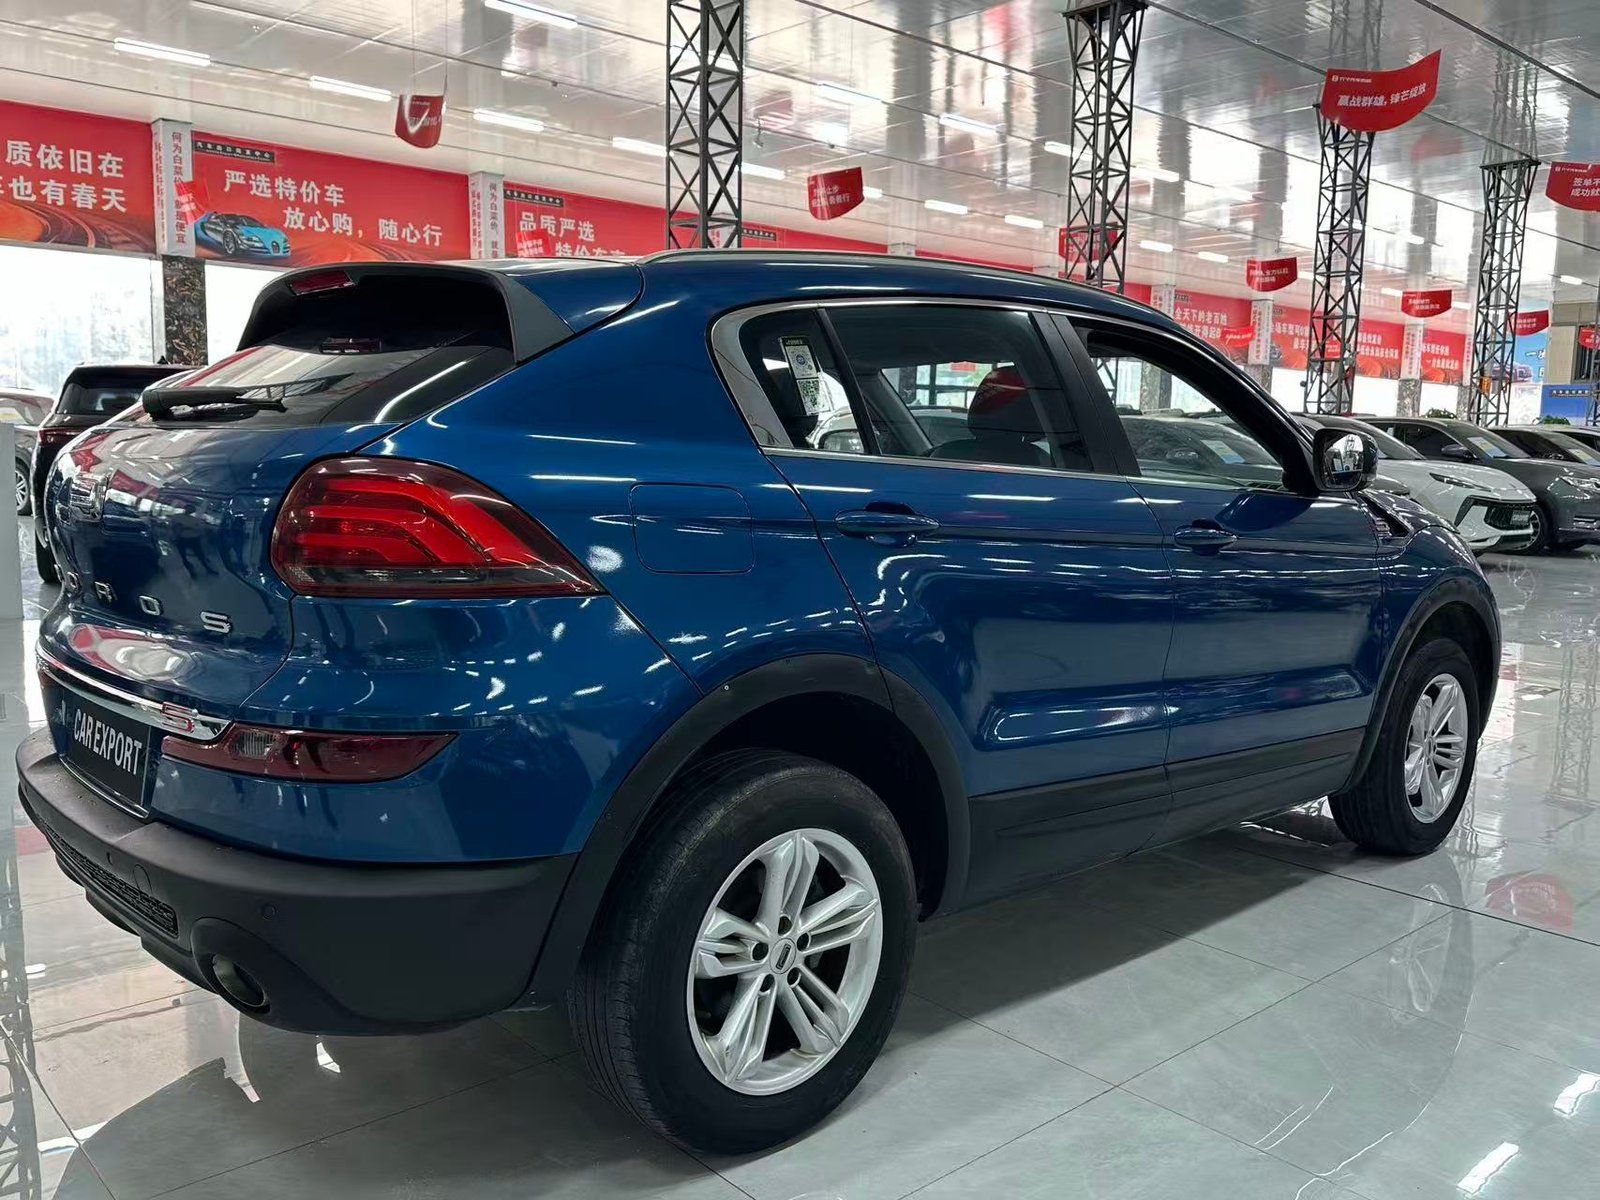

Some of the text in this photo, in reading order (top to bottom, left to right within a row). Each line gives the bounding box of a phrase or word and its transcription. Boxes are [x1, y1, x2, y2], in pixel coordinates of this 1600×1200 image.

[5, 139, 125, 178] 质依旧在
[223, 169, 345, 207] 严选特价车
[283, 207, 442, 246] 放心购，随心行
[520, 211, 595, 242] 品质严选
[73, 708, 143, 776] CAR EXPORT
